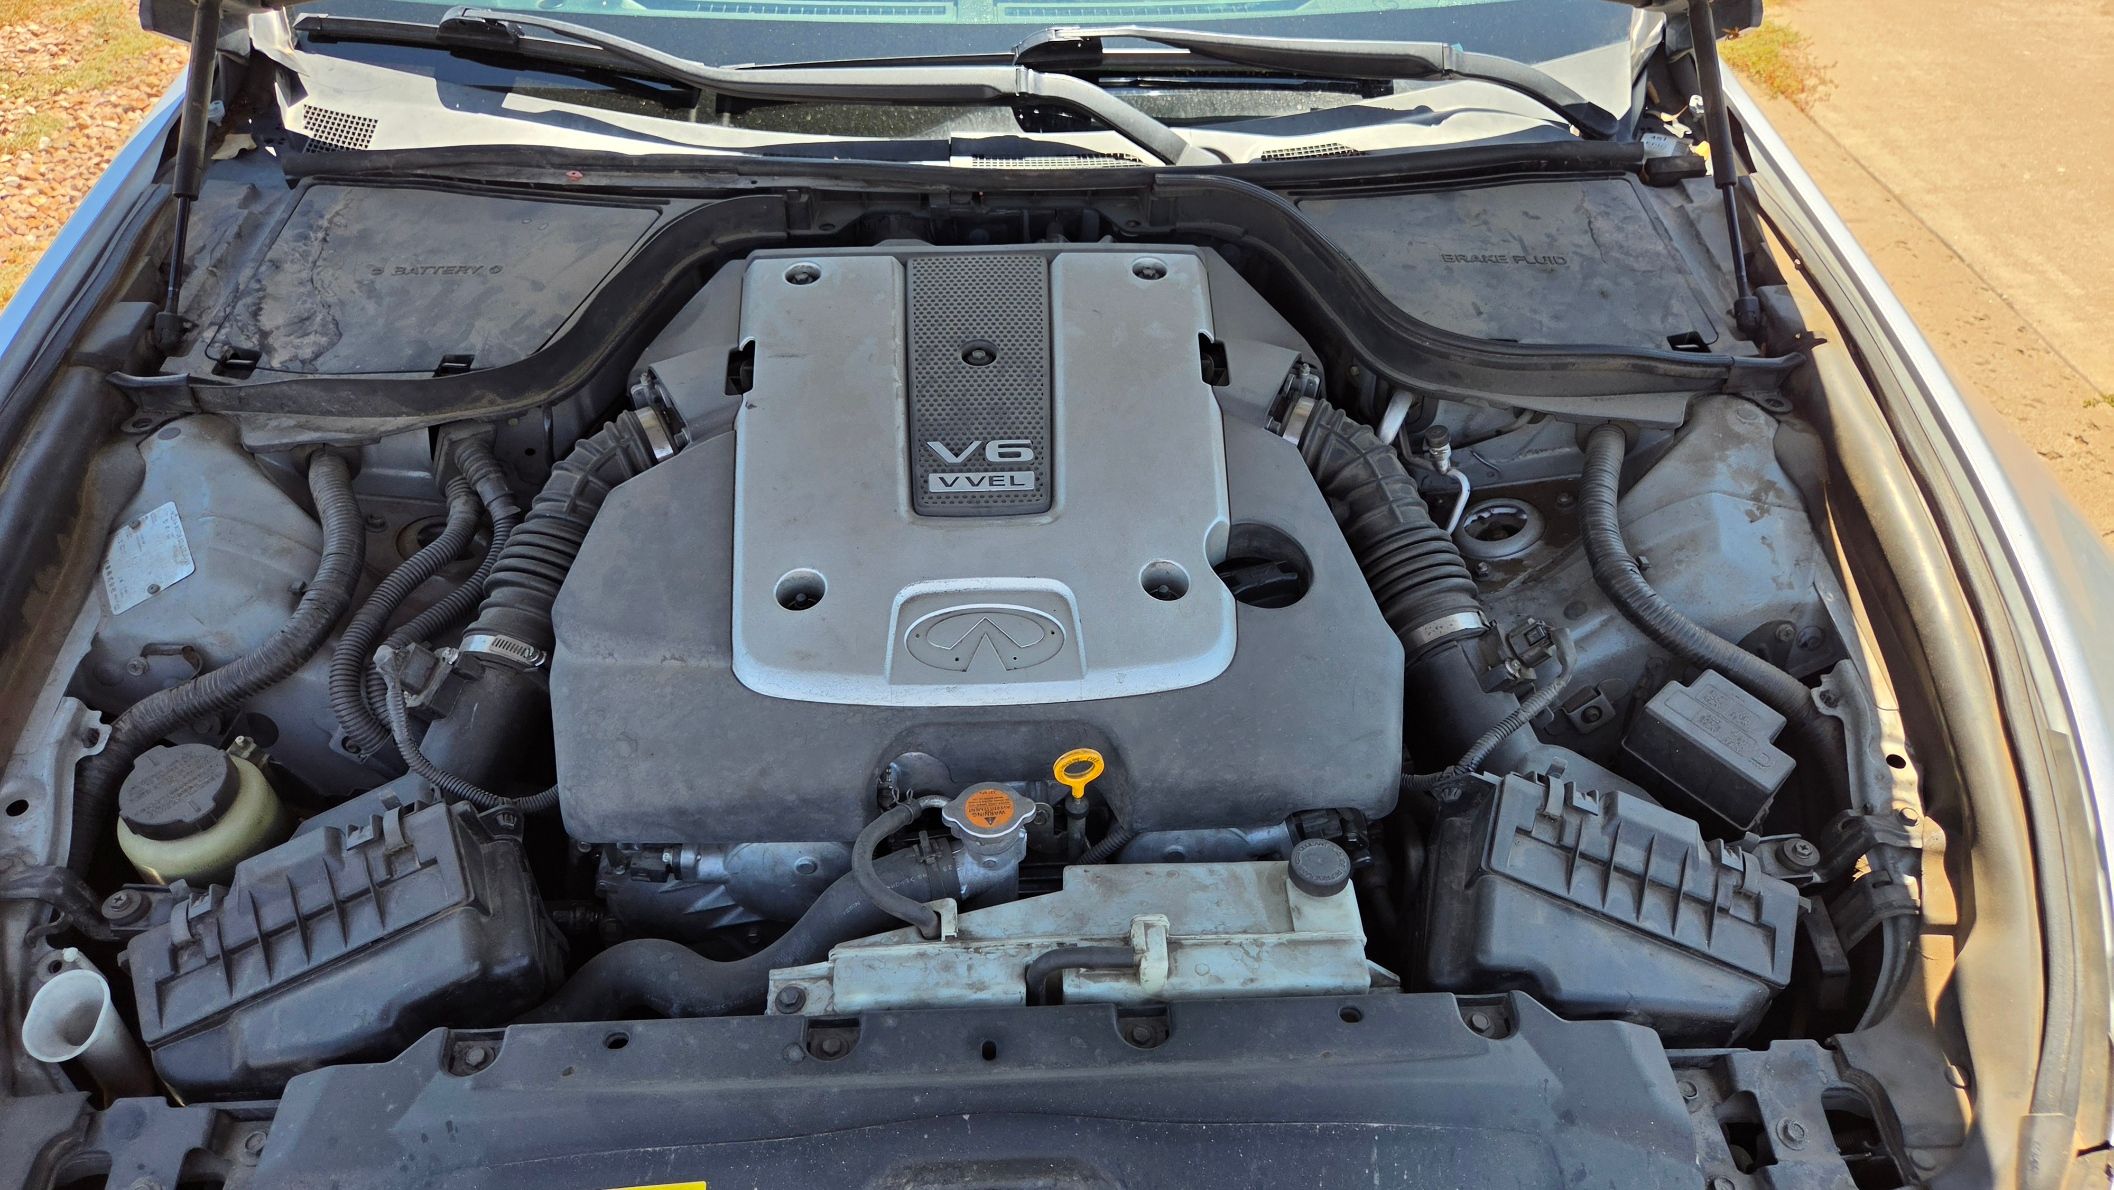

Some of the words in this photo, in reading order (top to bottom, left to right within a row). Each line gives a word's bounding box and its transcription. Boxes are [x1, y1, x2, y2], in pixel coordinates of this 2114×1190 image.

[1441, 253, 1508, 265] BRAKE
[1512, 254, 1568, 266] FLUID
[391, 264, 485, 277] BATTERY
[926, 439, 1035, 465] V6
[938, 475, 1026, 488] VVEL
[972, 810, 1006, 818] WARNING
